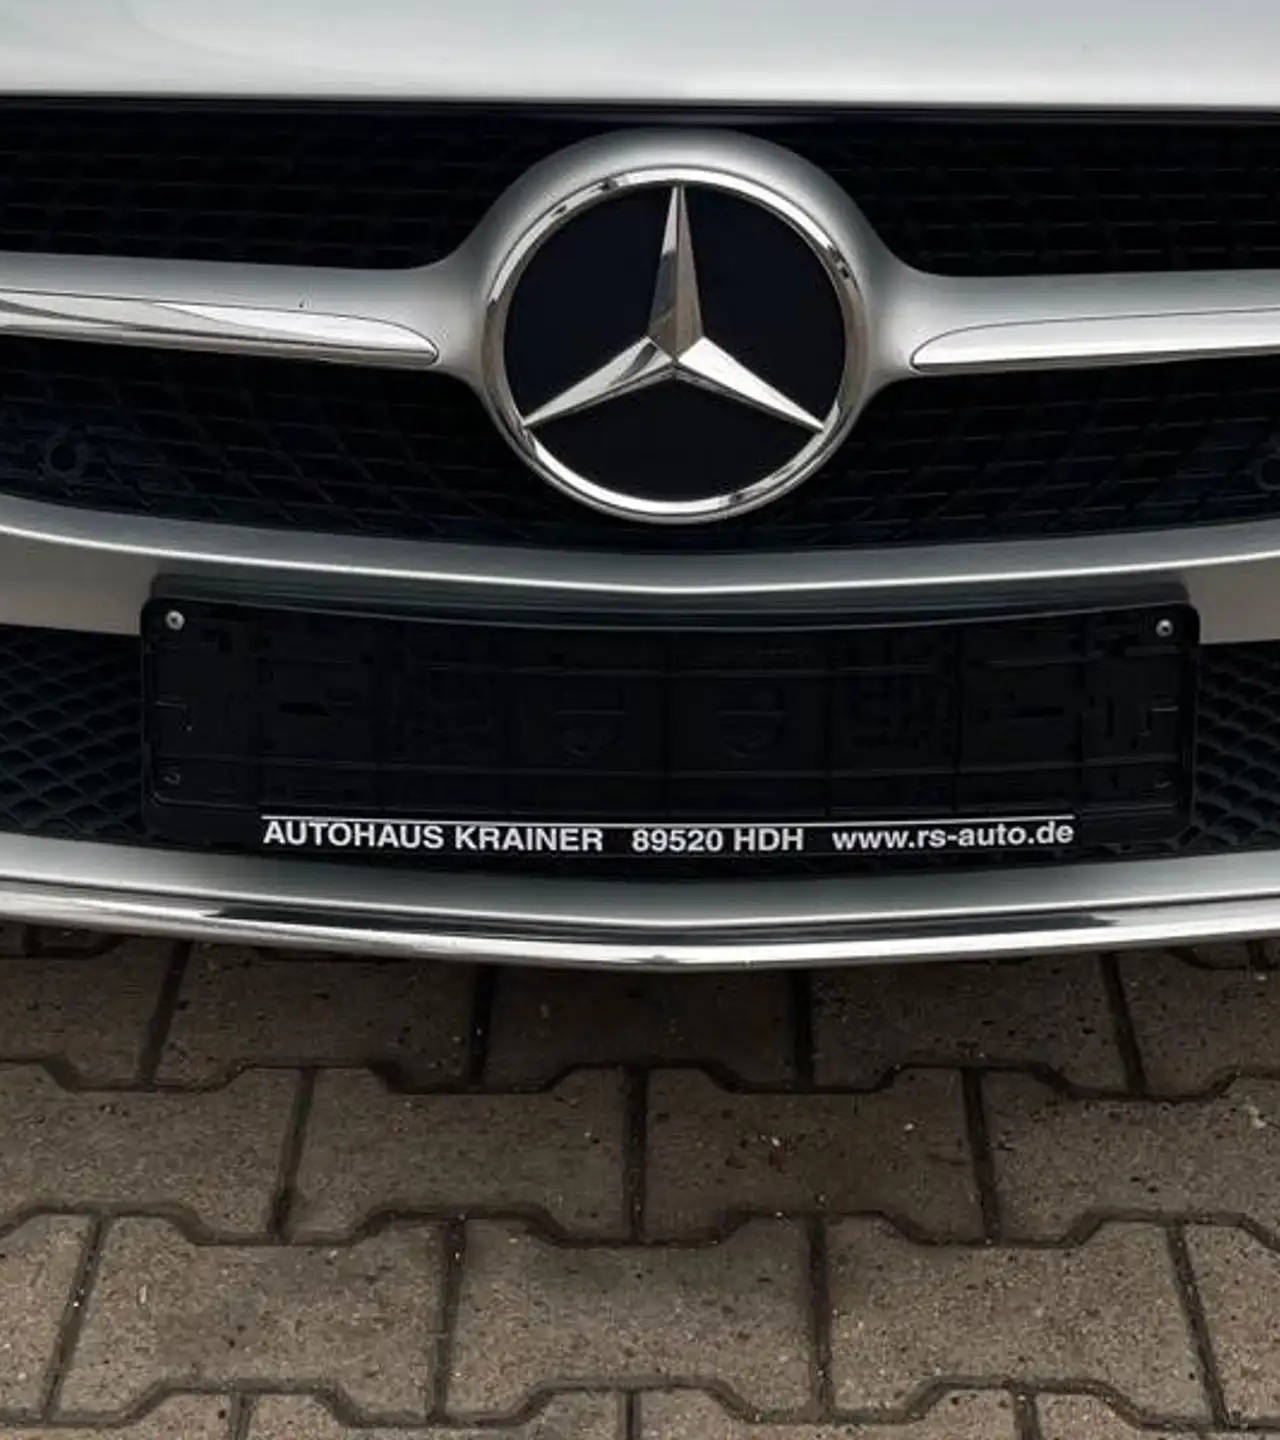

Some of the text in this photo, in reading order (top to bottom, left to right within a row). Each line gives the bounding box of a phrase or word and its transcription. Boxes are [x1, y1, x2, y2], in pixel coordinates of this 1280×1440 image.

[262, 820, 1075, 852] AUTOHAUS KRAINER 89520 HDH www.rs-auto.de
